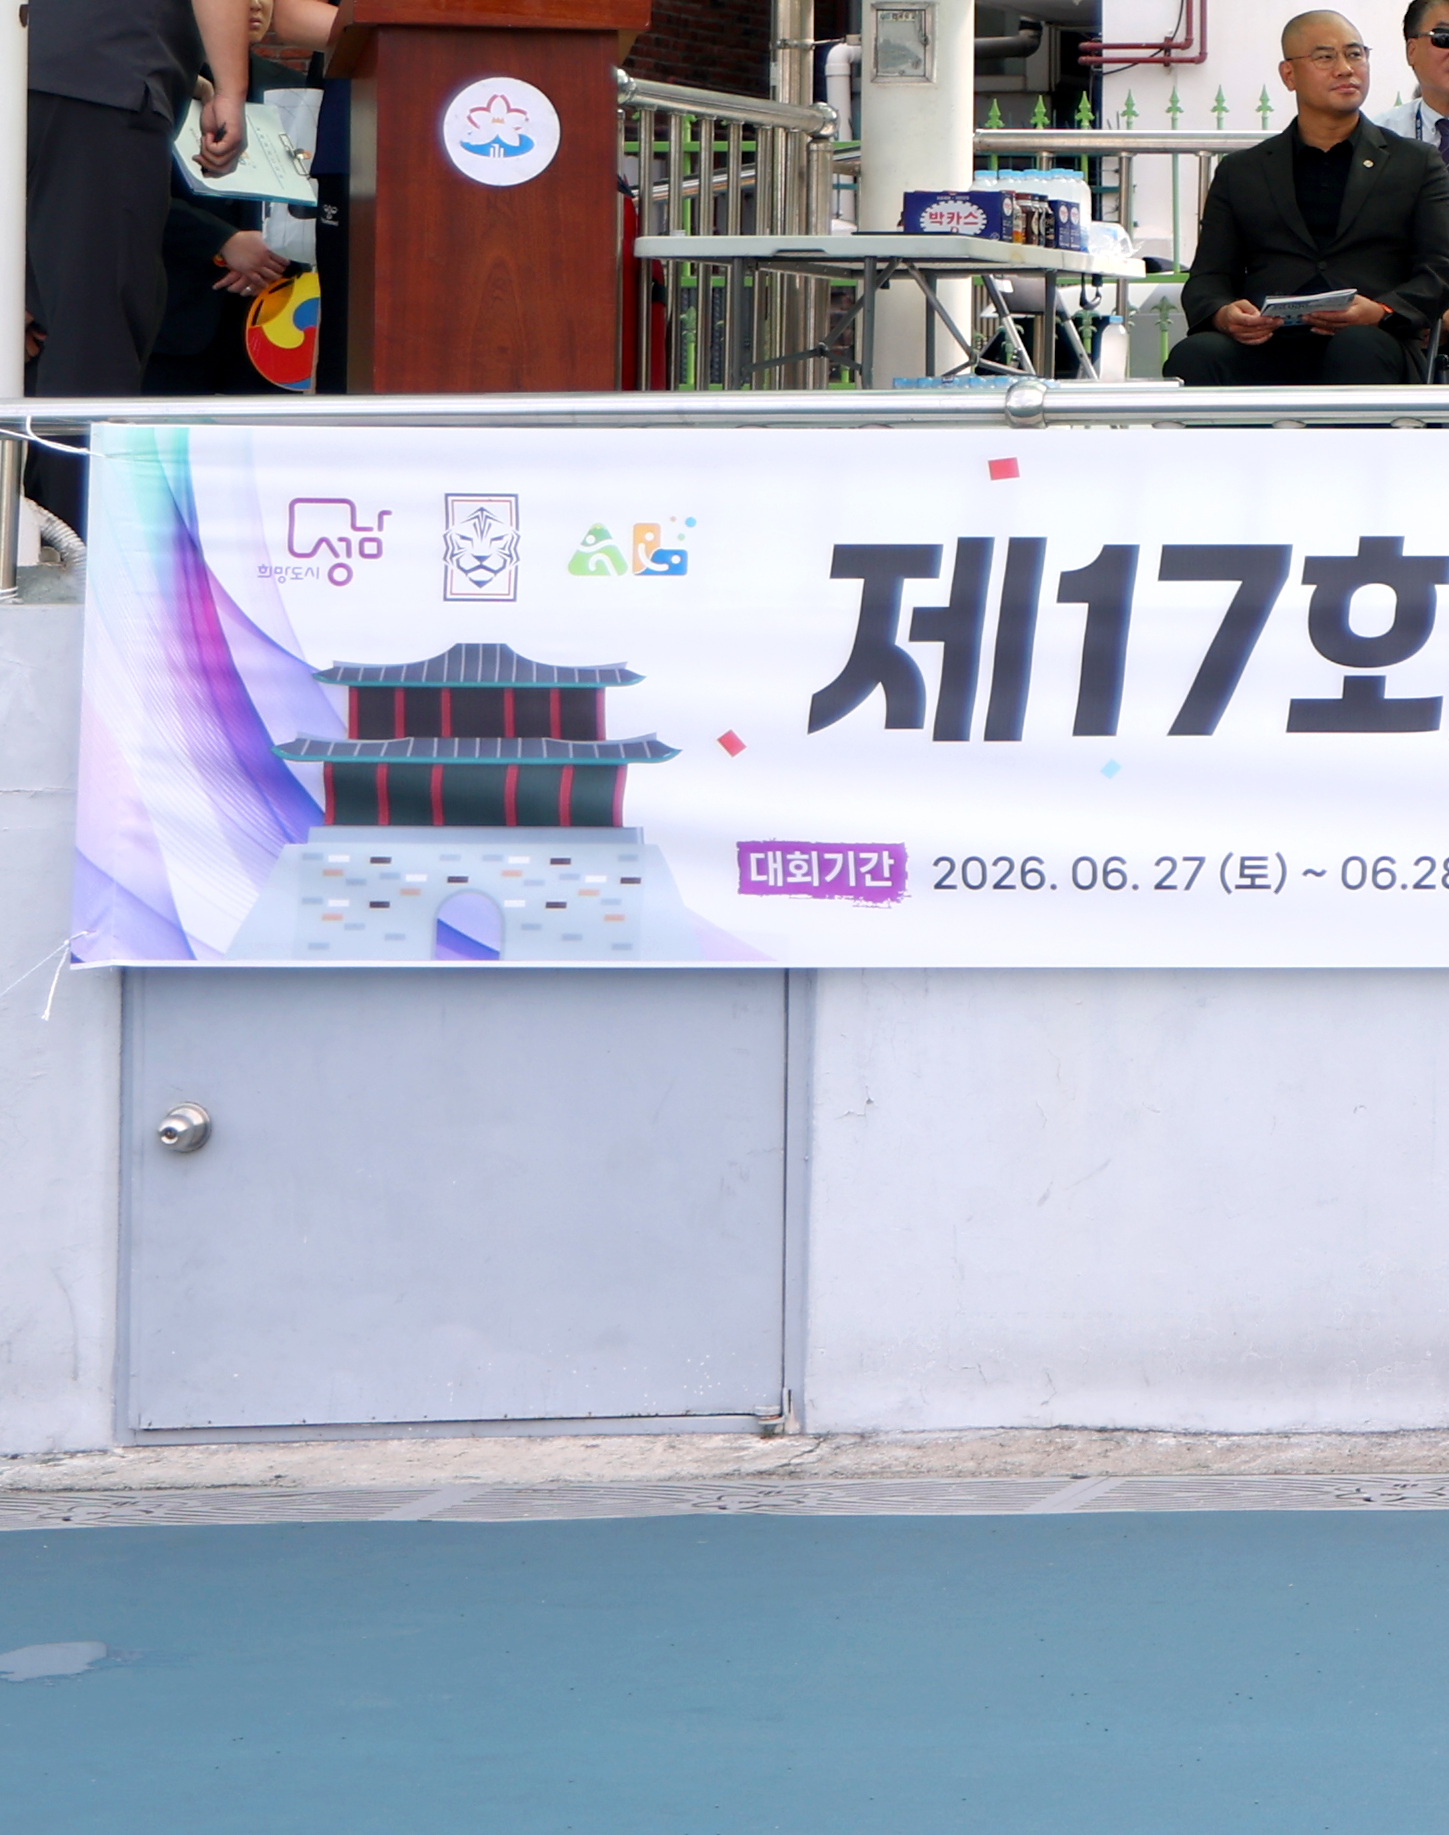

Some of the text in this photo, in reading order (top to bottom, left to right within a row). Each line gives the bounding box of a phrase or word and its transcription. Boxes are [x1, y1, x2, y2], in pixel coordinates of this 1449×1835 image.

[929, 211, 979, 226] 박카스
[257, 564, 320, 584] 희망도시
[749, 850, 894, 889] 대회기간
[933, 856, 1057, 890] 2026.
[1072, 856, 1139, 890] 06.
